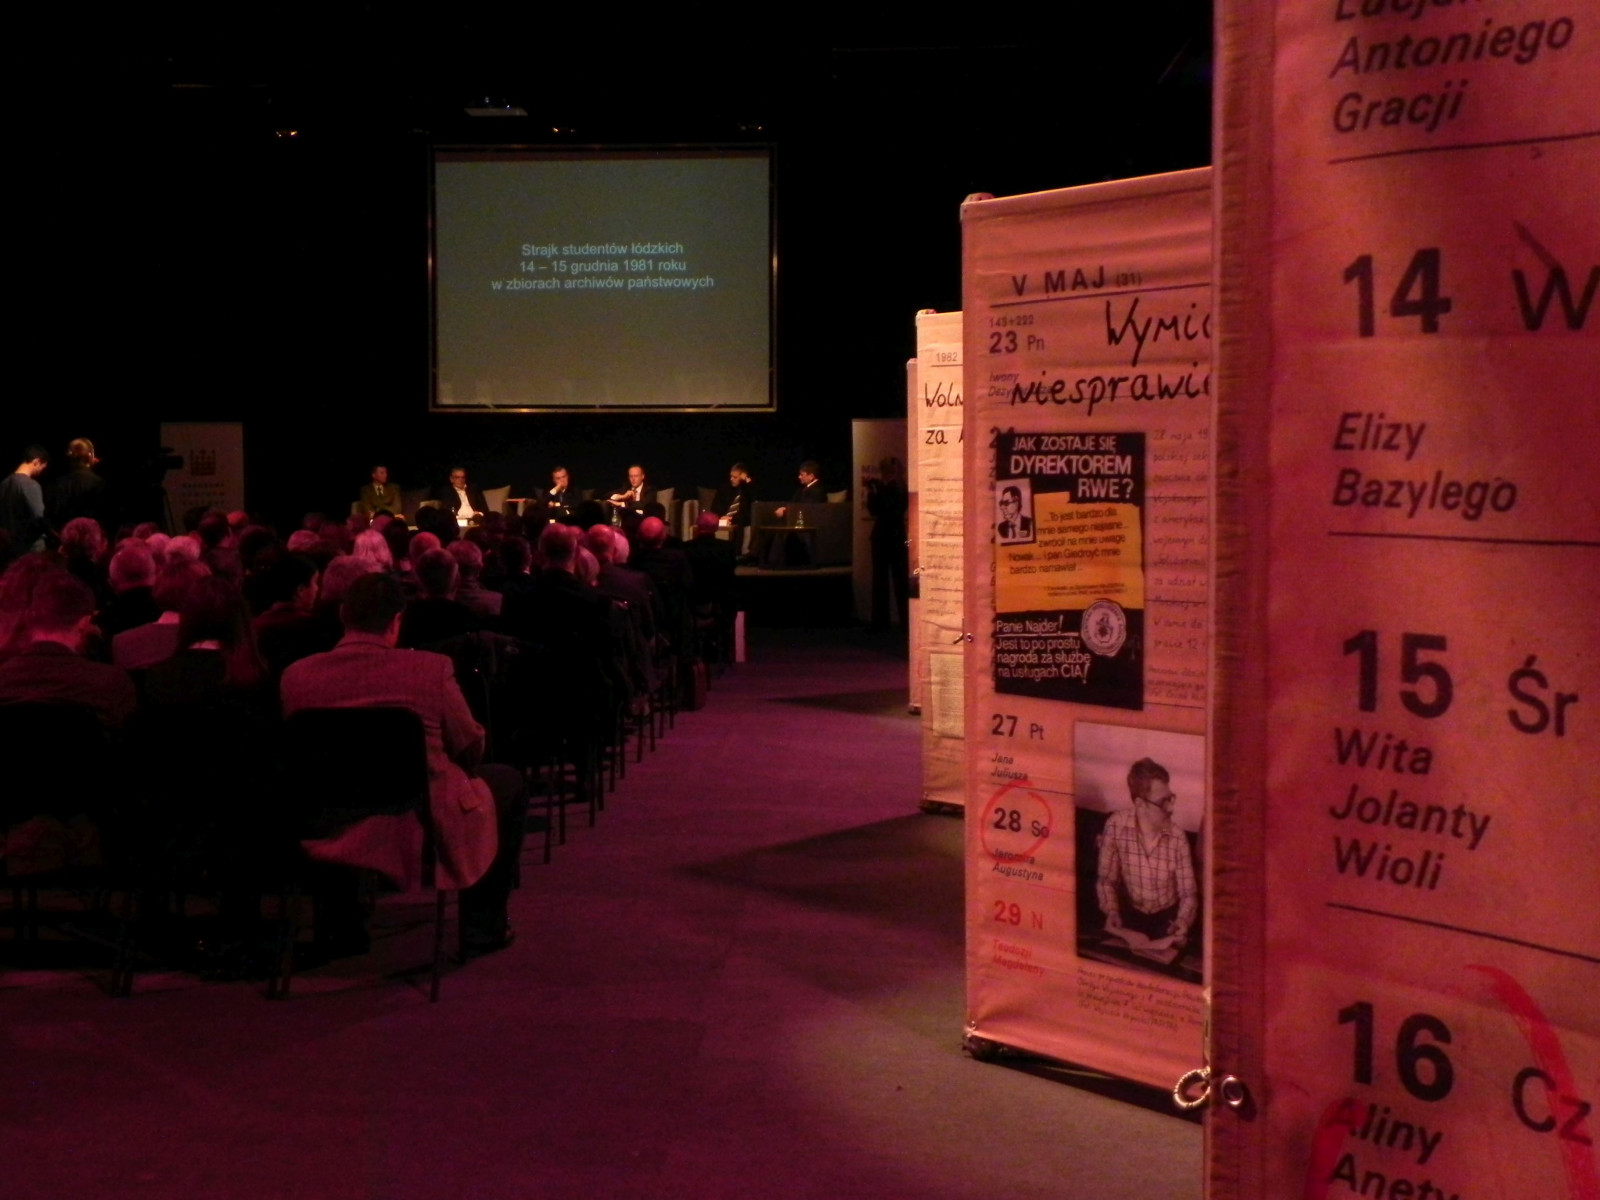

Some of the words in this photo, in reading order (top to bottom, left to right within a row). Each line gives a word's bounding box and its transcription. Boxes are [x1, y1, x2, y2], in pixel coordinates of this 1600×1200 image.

[1329, 16, 1574, 79] Antoniego
[1334, 79, 1468, 133] Gracji
[522, 243, 559, 258] Strajk
[562, 242, 627, 256] studentów
[631, 242, 684, 255] łódzkich
[520, 261, 535, 273] 14
[552, 260, 567, 273] 15
[571, 260, 619, 275] grudnia
[623, 259, 653, 272] 1981
[658, 258, 687, 272] roku
[1012, 273, 1027, 296] V
[1044, 265, 1106, 294] MAJ
[1116, 271, 1143, 287] (31)
[491, 279, 502, 290] w
[506, 276, 561, 290] zbiorach
[564, 275, 625, 289] archiwów
[628, 275, 714, 291] państwowych
[1344, 247, 1451, 337] 14
[989, 330, 1018, 354] 23
[1027, 334, 1045, 351] Pn
[1011, 361, 1210, 416] niesprawi
[925, 430, 948, 445] za
[1012, 435, 1037, 451] JAK
[1040, 435, 1096, 451] ZOSTAJE
[1098, 435, 1117, 454] SIĘ
[1333, 412, 1426, 461] Elizy
[1010, 454, 1132, 475] DYREKTOREM
[1333, 468, 1517, 520] Bazylego
[996, 619, 1023, 633] Panie
[1025, 614, 1064, 635] Najder!
[996, 638, 1018, 650] Jest
[1020, 638, 1030, 650] to
[1032, 639, 1045, 653] po
[1047, 637, 1080, 653] prostu
[997, 650, 1038, 667] nagroda
[1041, 652, 1053, 664] za
[998, 667, 1010, 678] na
[1012, 664, 1059, 682] usługach
[1061, 664, 1091, 684] CIA!
[1343, 629, 1453, 718] 15
[1508, 654, 1578, 737] Śr
[992, 714, 1018, 737] 27
[1030, 723, 1044, 740] Pt
[1334, 727, 1433, 775] Wita
[994, 807, 1021, 832] 28
[1330, 784, 1490, 850] Jolanty
[992, 862, 1044, 881] Augustyna
[1334, 836, 1445, 890] Wioli
[994, 900, 1021, 926] 29
[1032, 911, 1043, 930] N
[1338, 1001, 1453, 1102] 16
[1513, 1067, 1592, 1147] Cz
[1325, 1098, 1442, 1165] Aliny
[1331, 1152, 1460, 1200] Anet
